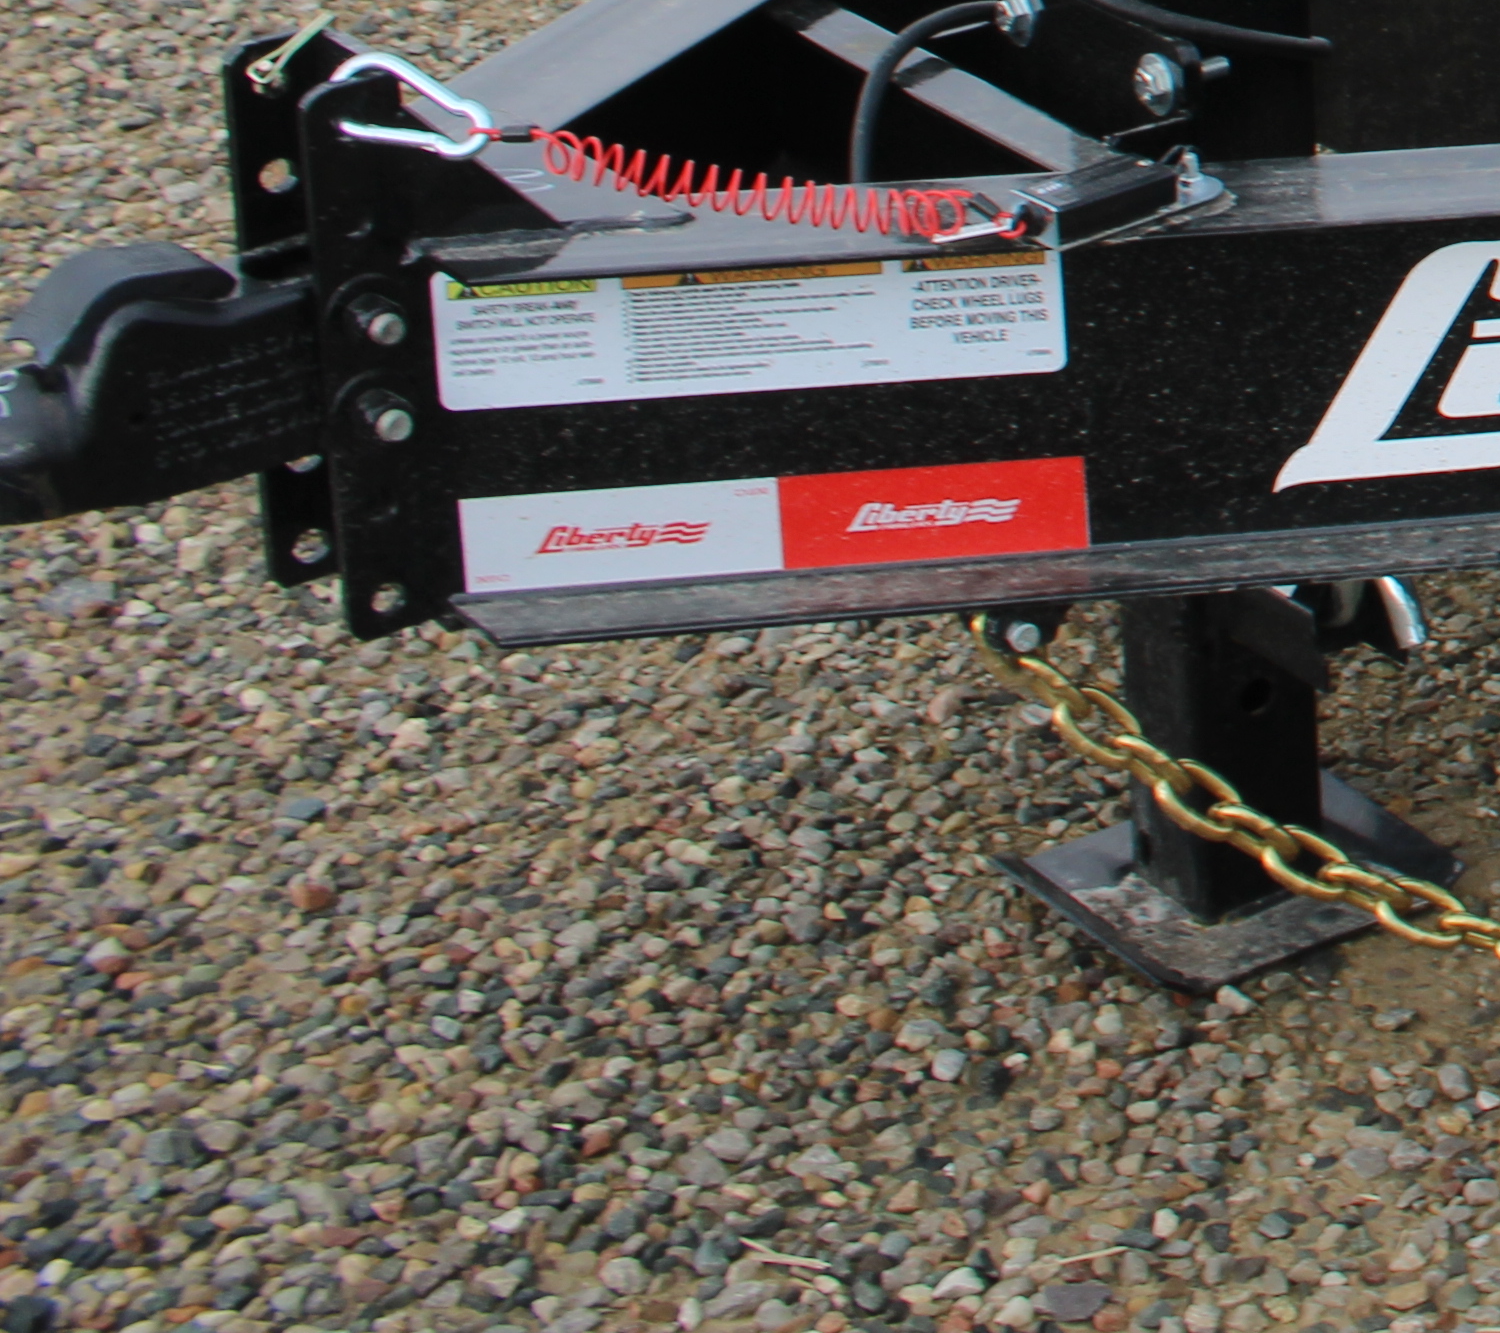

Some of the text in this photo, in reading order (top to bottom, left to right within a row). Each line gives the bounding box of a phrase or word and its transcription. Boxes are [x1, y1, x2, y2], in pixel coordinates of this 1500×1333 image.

[1008, 290, 1044, 305] LUGS
[910, 308, 1048, 330] BEFORE MOVING THIS
[953, 329, 1008, 344] VEHICLE
[846, 498, 970, 533] Liberty
[535, 521, 660, 555] Liberty
